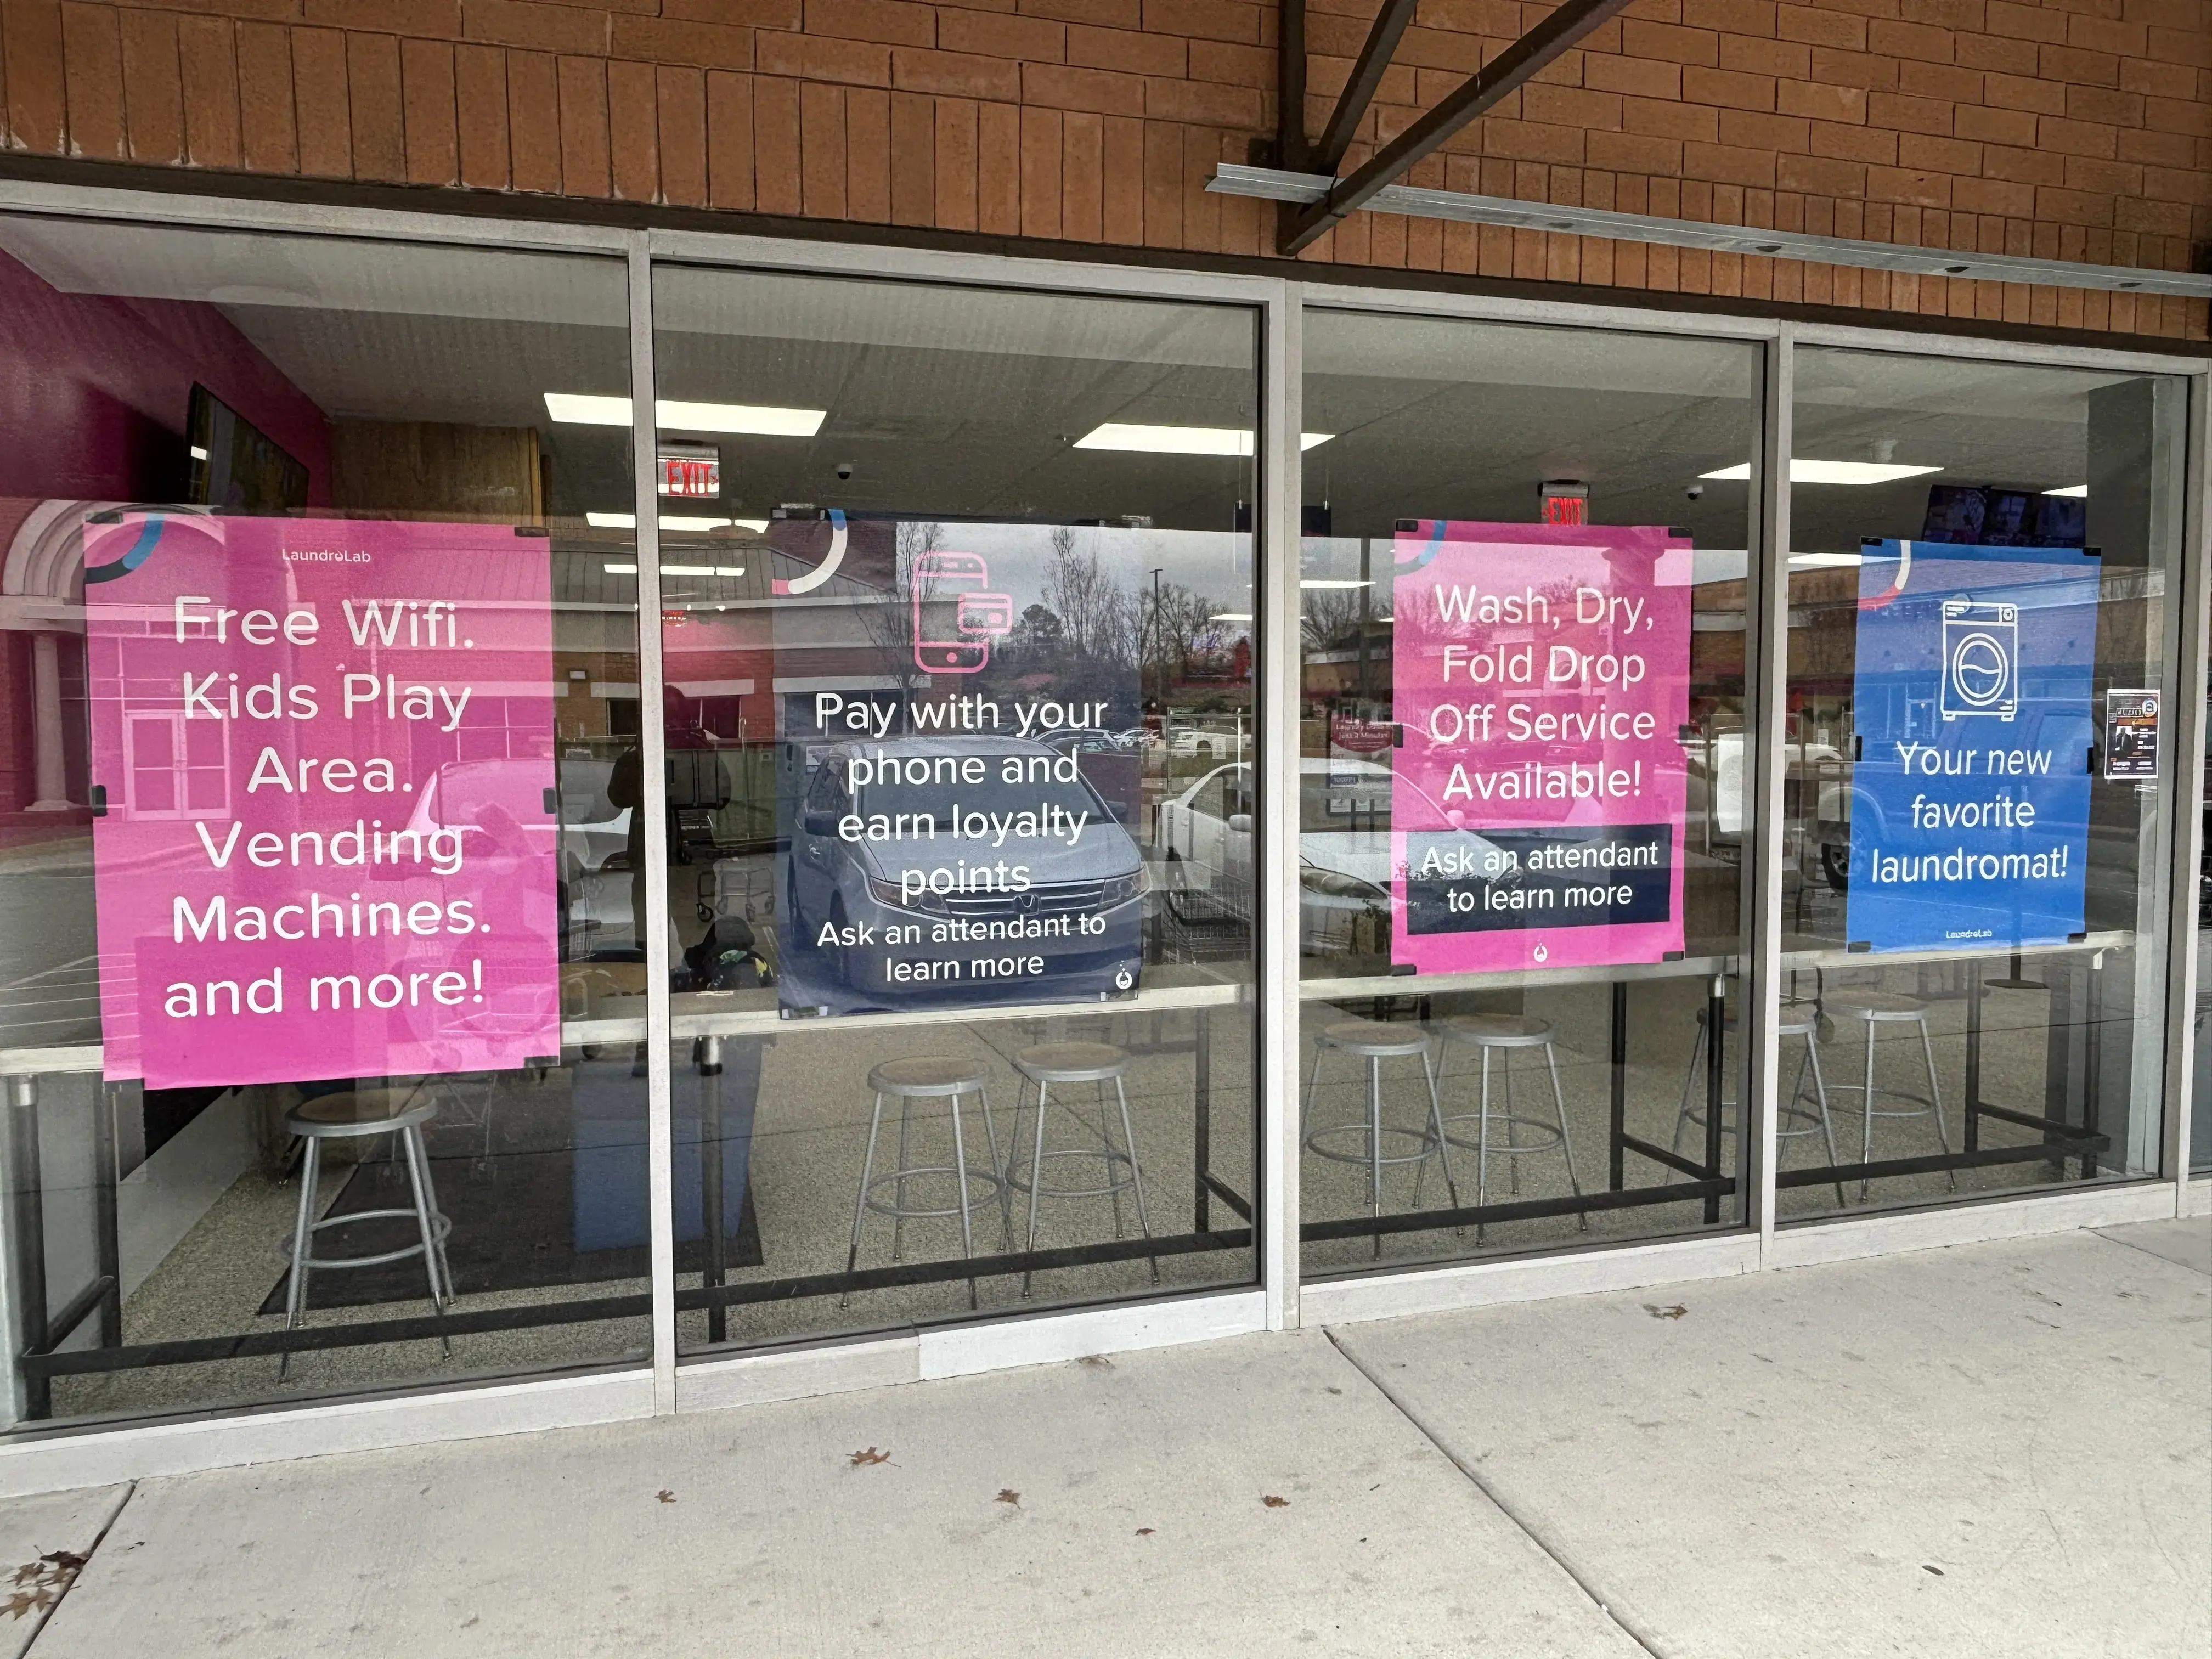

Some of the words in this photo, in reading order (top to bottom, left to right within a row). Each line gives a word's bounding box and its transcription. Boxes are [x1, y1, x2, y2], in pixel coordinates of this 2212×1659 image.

[667, 461, 712, 496] EXIT
[1548, 497, 1582, 525] EXIT
[282, 549, 371, 562] LaundroLab
[175, 596, 320, 646] Free
[342, 599, 474, 648] Wifi.
[1436, 584, 1561, 630] Wash,
[1576, 586, 1653, 634] Dry,
[1443, 645, 1532, 684] Fold
[1549, 646, 1645, 691] Drop
[183, 672, 318, 720] Kids
[343, 672, 472, 731] Play
[815, 693, 896, 738] Pay
[912, 693, 998, 729] with
[1015, 699, 1108, 738] your
[1430, 703, 1496, 742] Off
[1507, 704, 1655, 742] Service
[247, 747, 412, 793] Area.
[848, 748, 986, 794] phone
[1002, 747, 1078, 783] and
[1897, 741, 1977, 775] Your
[1988, 748, 2052, 774] new
[1443, 760, 1641, 800] Available!
[838, 814, 935, 843] earn
[953, 803, 1088, 847] loyalty
[1911, 794, 2035, 828] favorite
[195, 819, 462, 874] Vending
[1422, 845, 1474, 875] Ask
[1485, 852, 1517, 871] an
[1528, 842, 1658, 870] attendant
[1872, 845, 2068, 883] laundromat!
[901, 860, 1031, 904] points
[1448, 888, 1475, 912] to
[1484, 885, 1553, 910] learn
[1565, 885, 1633, 907] more
[173, 893, 490, 943] Machines.
[817, 921, 874, 946] Ask
[885, 927, 920, 945] an
[932, 915, 1071, 942] attendant
[1077, 915, 1105, 935] to
[165, 967, 282, 1018] and
[311, 958, 483, 1011] more!
[887, 957, 960, 981] learn
[972, 957, 1044, 978] more
